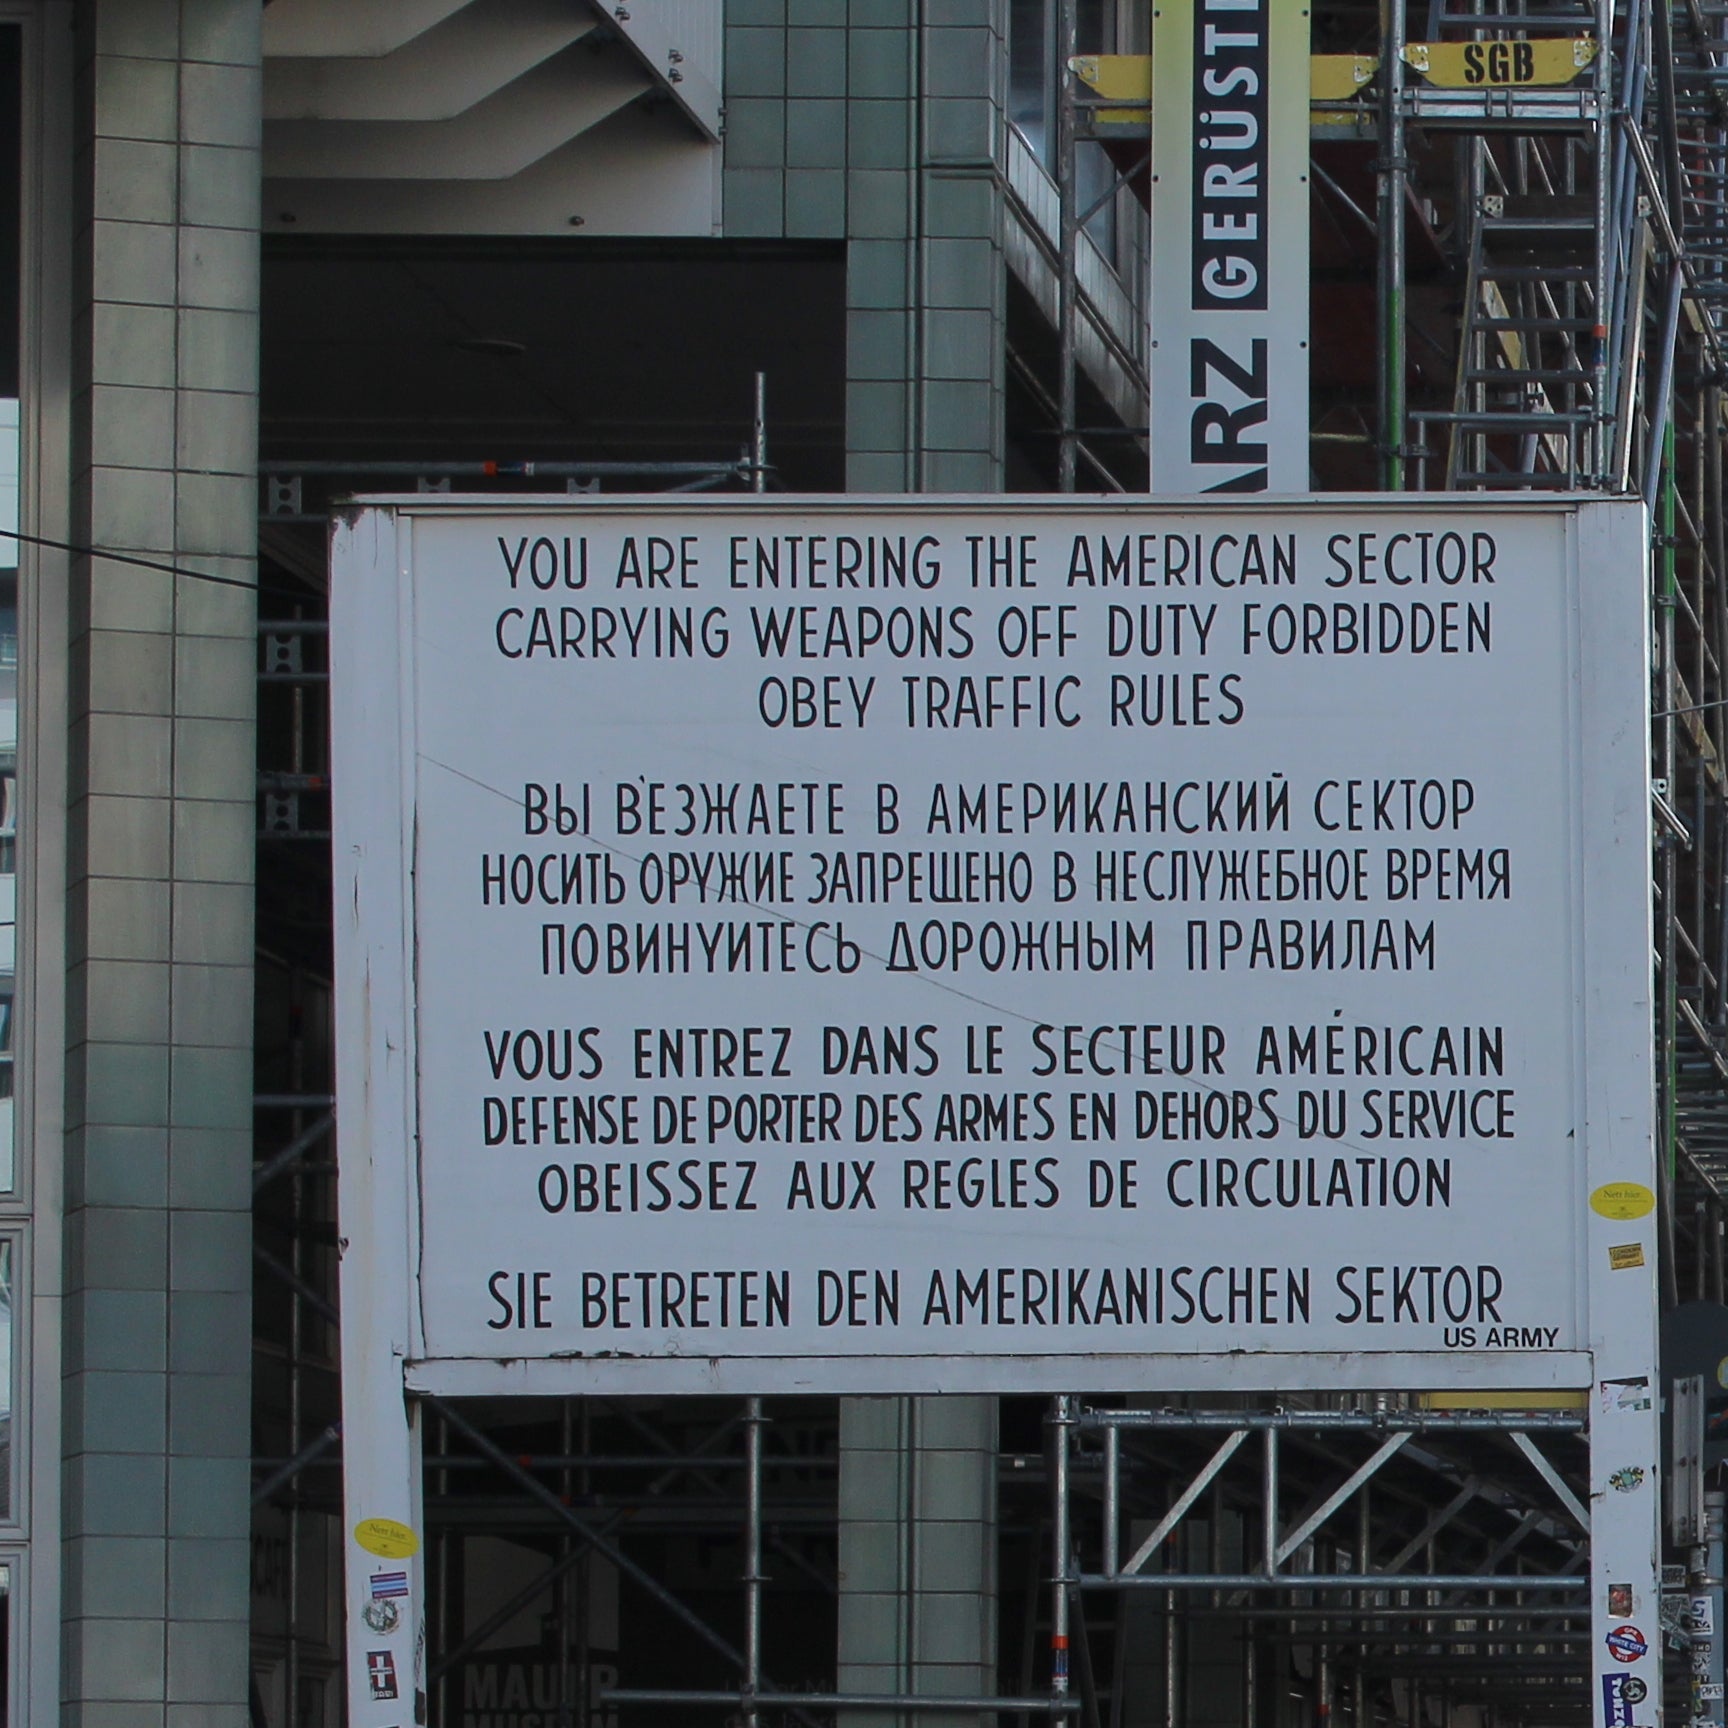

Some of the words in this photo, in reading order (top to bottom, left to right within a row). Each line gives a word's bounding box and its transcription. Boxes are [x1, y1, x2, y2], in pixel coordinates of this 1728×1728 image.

[1463, 42, 1534, 84] SGB
[1200, 0, 1259, 300] GERÜST
[498, 536, 586, 590] YOU
[616, 536, 698, 590] ARE
[731, 536, 939, 590] ENTERING
[966, 536, 1036, 590] THE
[1068, 536, 1295, 590] AMERICAN
[1326, 532, 1495, 590] SECTOR
[497, 604, 728, 659] CARRYING
[751, 604, 973, 659] WEAPONS
[999, 604, 1076, 659] OFF
[1109, 604, 1216, 659] DUTY
[1244, 604, 1489, 659] FORBIDDEN
[760, 674, 874, 728] OBEY
[903, 674, 1080, 728] TRAFFIC
[1112, 674, 1243, 728] RULES
[525, 781, 589, 836] ВЫ
[878, 781, 898, 836] В
[928, 773, 1288, 836] АМЕРИКАНСКИЙ
[1315, 781, 1473, 836] СЕКТОР
[483, 849, 625, 905] НОСИТЬ
[640, 849, 793, 905] ОРУЖИЕ
[1055, 849, 1076, 905] В
[1097, 849, 1367, 905] НЕСЛУЖЕБНОЕ
[1388, 849, 1509, 905] ВРЕМЯ
[886, 919, 1152, 974] ДОРОЖНЫМ
[1188, 919, 1433, 974] ПРАВИЛАМ
[484, 1025, 602, 1080] VOUS
[635, 1025, 790, 1080] ENTREZ
[824, 1025, 938, 1080] DANS
[968, 1025, 1002, 1080] LE
[1032, 1025, 1224, 1080] SECTEUR
[1257, 1010, 1502, 1080] AMÉRICAIN
[484, 1090, 638, 1145] DEFENSE
[654, 1090, 696, 1145] DE
[708, 1090, 841, 1145] PORTER
[856, 1090, 921, 1145] DES
[935, 1090, 1054, 1145] ARMES
[1071, 1090, 1115, 1145] EN
[1136, 1090, 1278, 1145] DEHORS
[1299, 1090, 1345, 1145] DU
[1361, 1090, 1513, 1145] SERVICE
[539, 1158, 756, 1213] OBEISSEZ
[788, 1158, 875, 1213] AUX
[905, 1158, 1058, 1213] REGLES
[1090, 1158, 1136, 1213] DE
[1168, 1158, 1449, 1213] CIRCULATION
[488, 1265, 551, 1329] SIE
[583, 1265, 789, 1329] BETRETEN
[818, 1265, 898, 1329] DEN
[924, 1265, 1308, 1329] AMERIKANISCHEN
[1336, 1265, 1502, 1329] SEKTOR
[1443, 1328, 1477, 1347] US
[1486, 1327, 1559, 1348] ARMY
